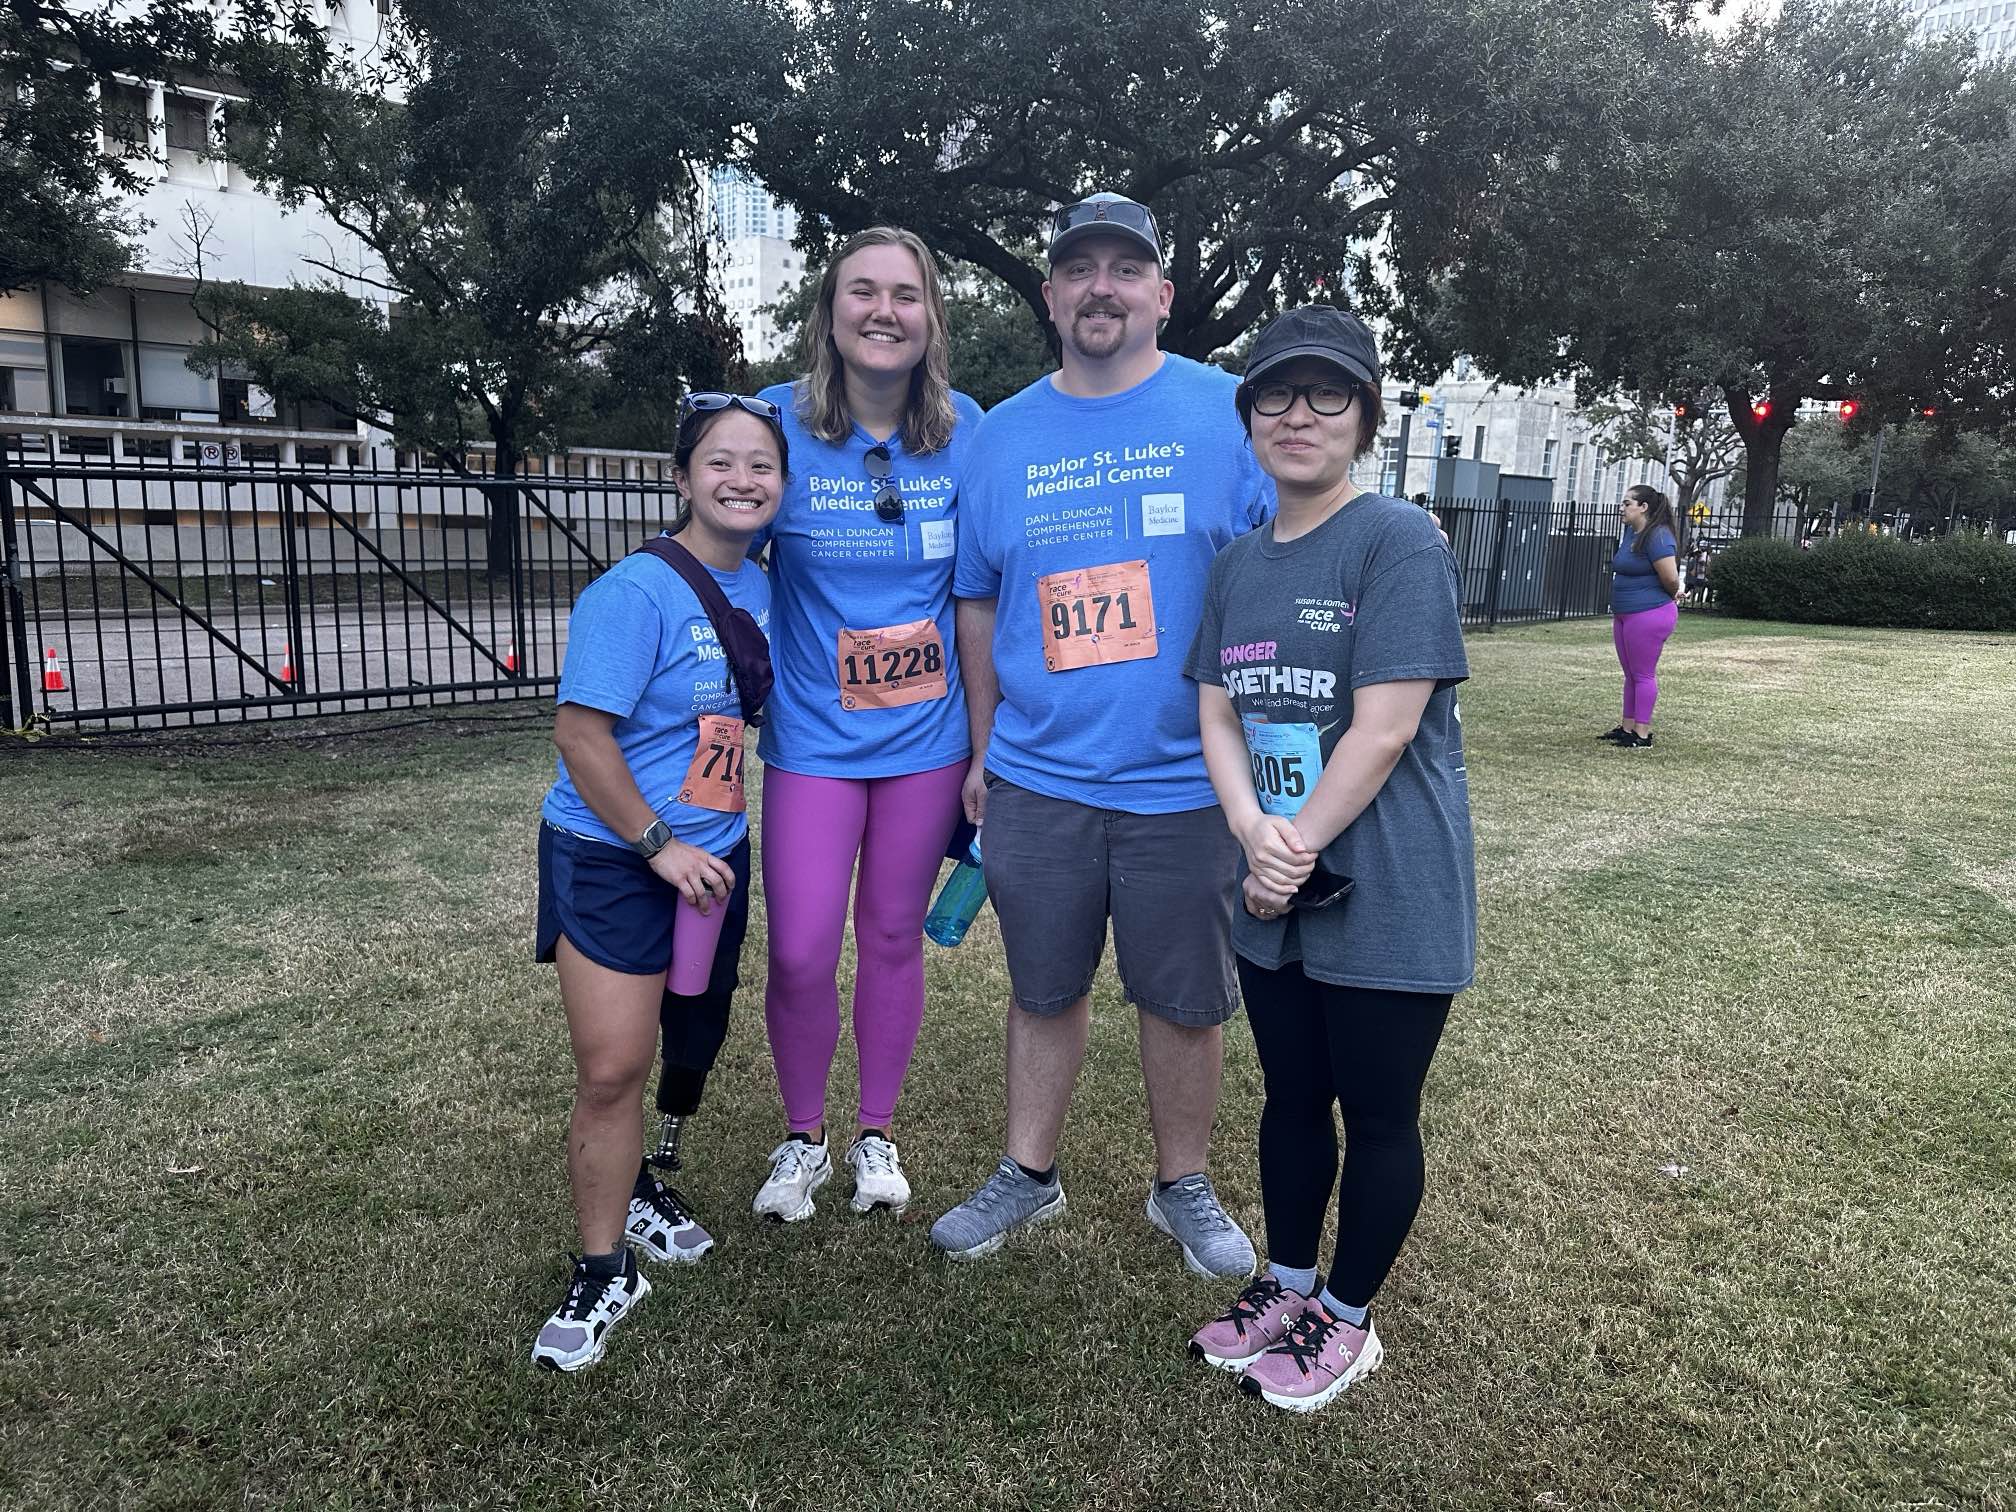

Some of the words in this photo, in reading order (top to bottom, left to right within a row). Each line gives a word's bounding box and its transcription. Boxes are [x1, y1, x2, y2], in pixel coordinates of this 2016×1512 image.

[1027, 457, 1087, 480] Baylor
[1093, 451, 1117, 467] St.
[1124, 442, 1185, 462] Luke's
[809, 476, 865, 495] Baylor
[900, 475, 952, 492] Luke's
[1026, 470, 1100, 499] Medical
[1107, 465, 1173, 484] Center
[810, 496, 875, 511] Medica
[903, 496, 945, 511] enter
[1148, 504, 1179, 516] Baylor
[1026, 514, 1048, 526] DAN
[1053, 511, 1059, 521] L
[1062, 505, 1112, 519] DUNCAN
[811, 528, 834, 537] DAN
[837, 529, 845, 537] L
[846, 528, 894, 537] DUNCAN
[1026, 518, 1112, 537] COMPREHENSIVE
[811, 539, 894, 548] COMPREHENSIVE
[1027, 535, 1069, 548] CANCER
[1073, 529, 1113, 541] CENTER
[811, 550, 852, 558] CANCER
[1049, 584, 1067, 593] race
[1056, 590, 1072, 598] cure
[1051, 592, 1137, 640] 9171
[1299, 608, 1334, 622] race
[690, 625, 719, 642] Bay
[853, 640, 871, 648] race
[1220, 640, 1277, 667] RONGER
[844, 643, 941, 685] 11228
[695, 681, 718, 691] DAN
[1222, 666, 1337, 698] OGETHER
[691, 700, 727, 711] CANCER
[1283, 697, 1308, 709] Breast
[1310, 704, 1334, 713] ancer
[1253, 752, 1306, 798] 805
